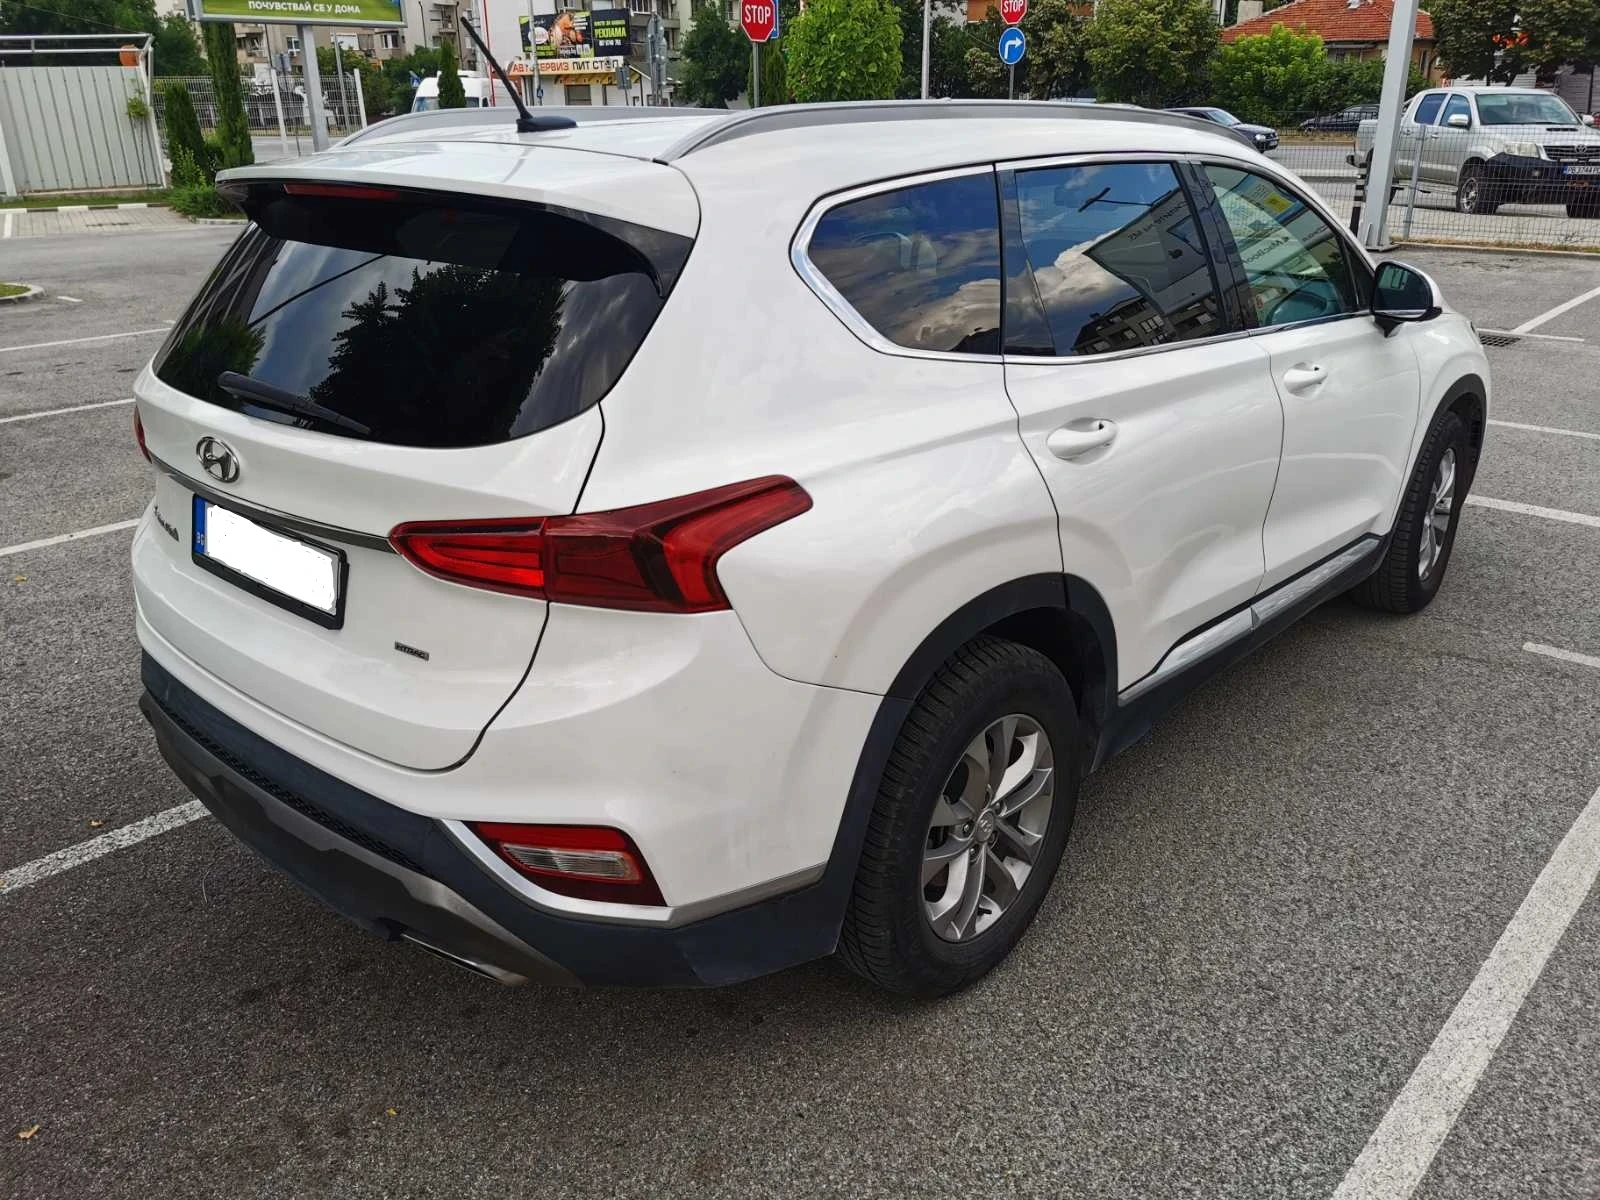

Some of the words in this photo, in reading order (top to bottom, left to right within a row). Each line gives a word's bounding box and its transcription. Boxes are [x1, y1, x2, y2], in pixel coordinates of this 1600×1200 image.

[248, 0, 312, 12] ПОЧУВСТВАЙ
[313, 4, 325, 12] СЕ
[324, 4, 333, 13] У
[335, 5, 361, 14] ДОМА
[1003, 0, 1024, 13] STOP
[744, 4, 771, 25] STOP
[594, 27, 626, 39] РЕКЛАМА
[572, 61, 590, 71] ПИТ
